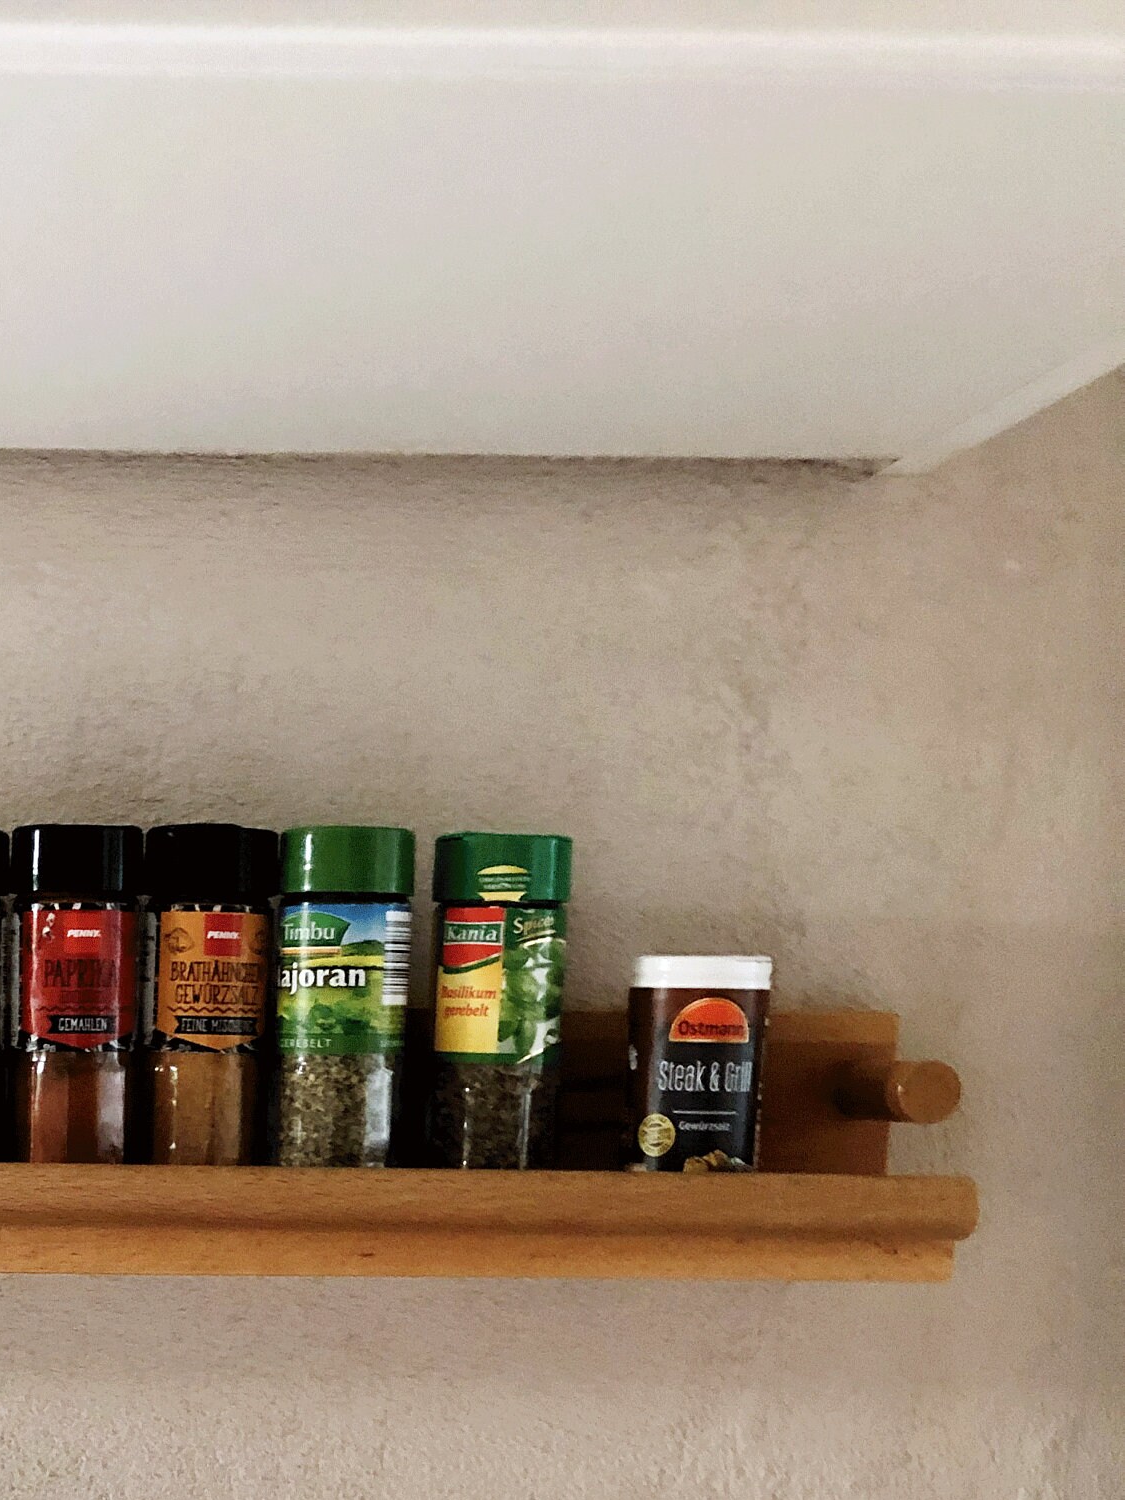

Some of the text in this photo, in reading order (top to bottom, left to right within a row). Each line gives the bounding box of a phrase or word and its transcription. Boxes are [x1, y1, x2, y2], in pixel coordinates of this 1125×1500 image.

[281, 919, 336, 941] Timbu
[446, 925, 498, 941] Kania
[277, 964, 366, 996] ajoran
[58, 1017, 108, 1032] GEMAHLEN
[678, 1019, 745, 1036] Ostmann
[657, 1060, 754, 1093] Steak & Grill
